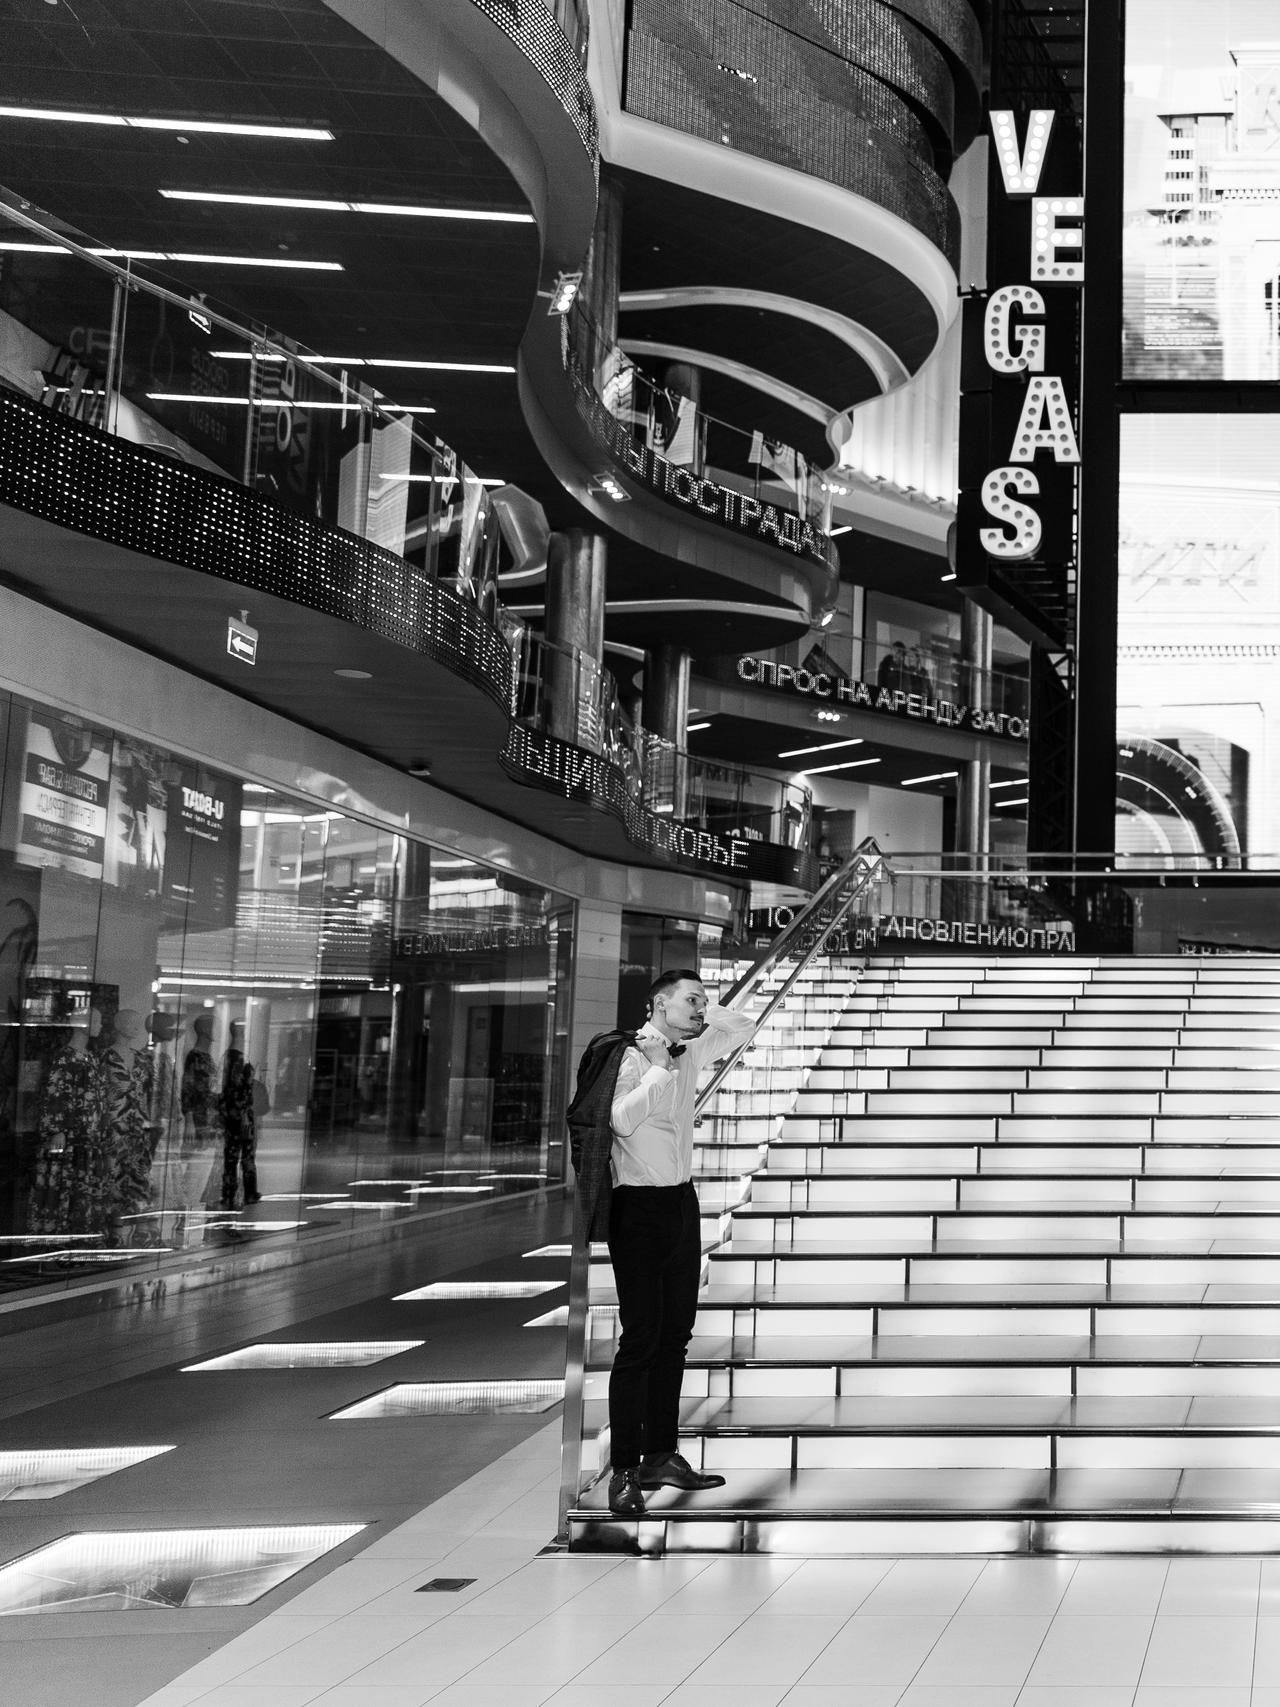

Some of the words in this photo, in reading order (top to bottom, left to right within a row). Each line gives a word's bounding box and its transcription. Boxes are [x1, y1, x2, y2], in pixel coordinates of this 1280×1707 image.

[980, 110, 1085, 557] VEGAS
[737, 656, 832, 697] СПРОС
[837, 677, 872, 706] НА
[875, 687, 967, 727] АРЕНДУ
